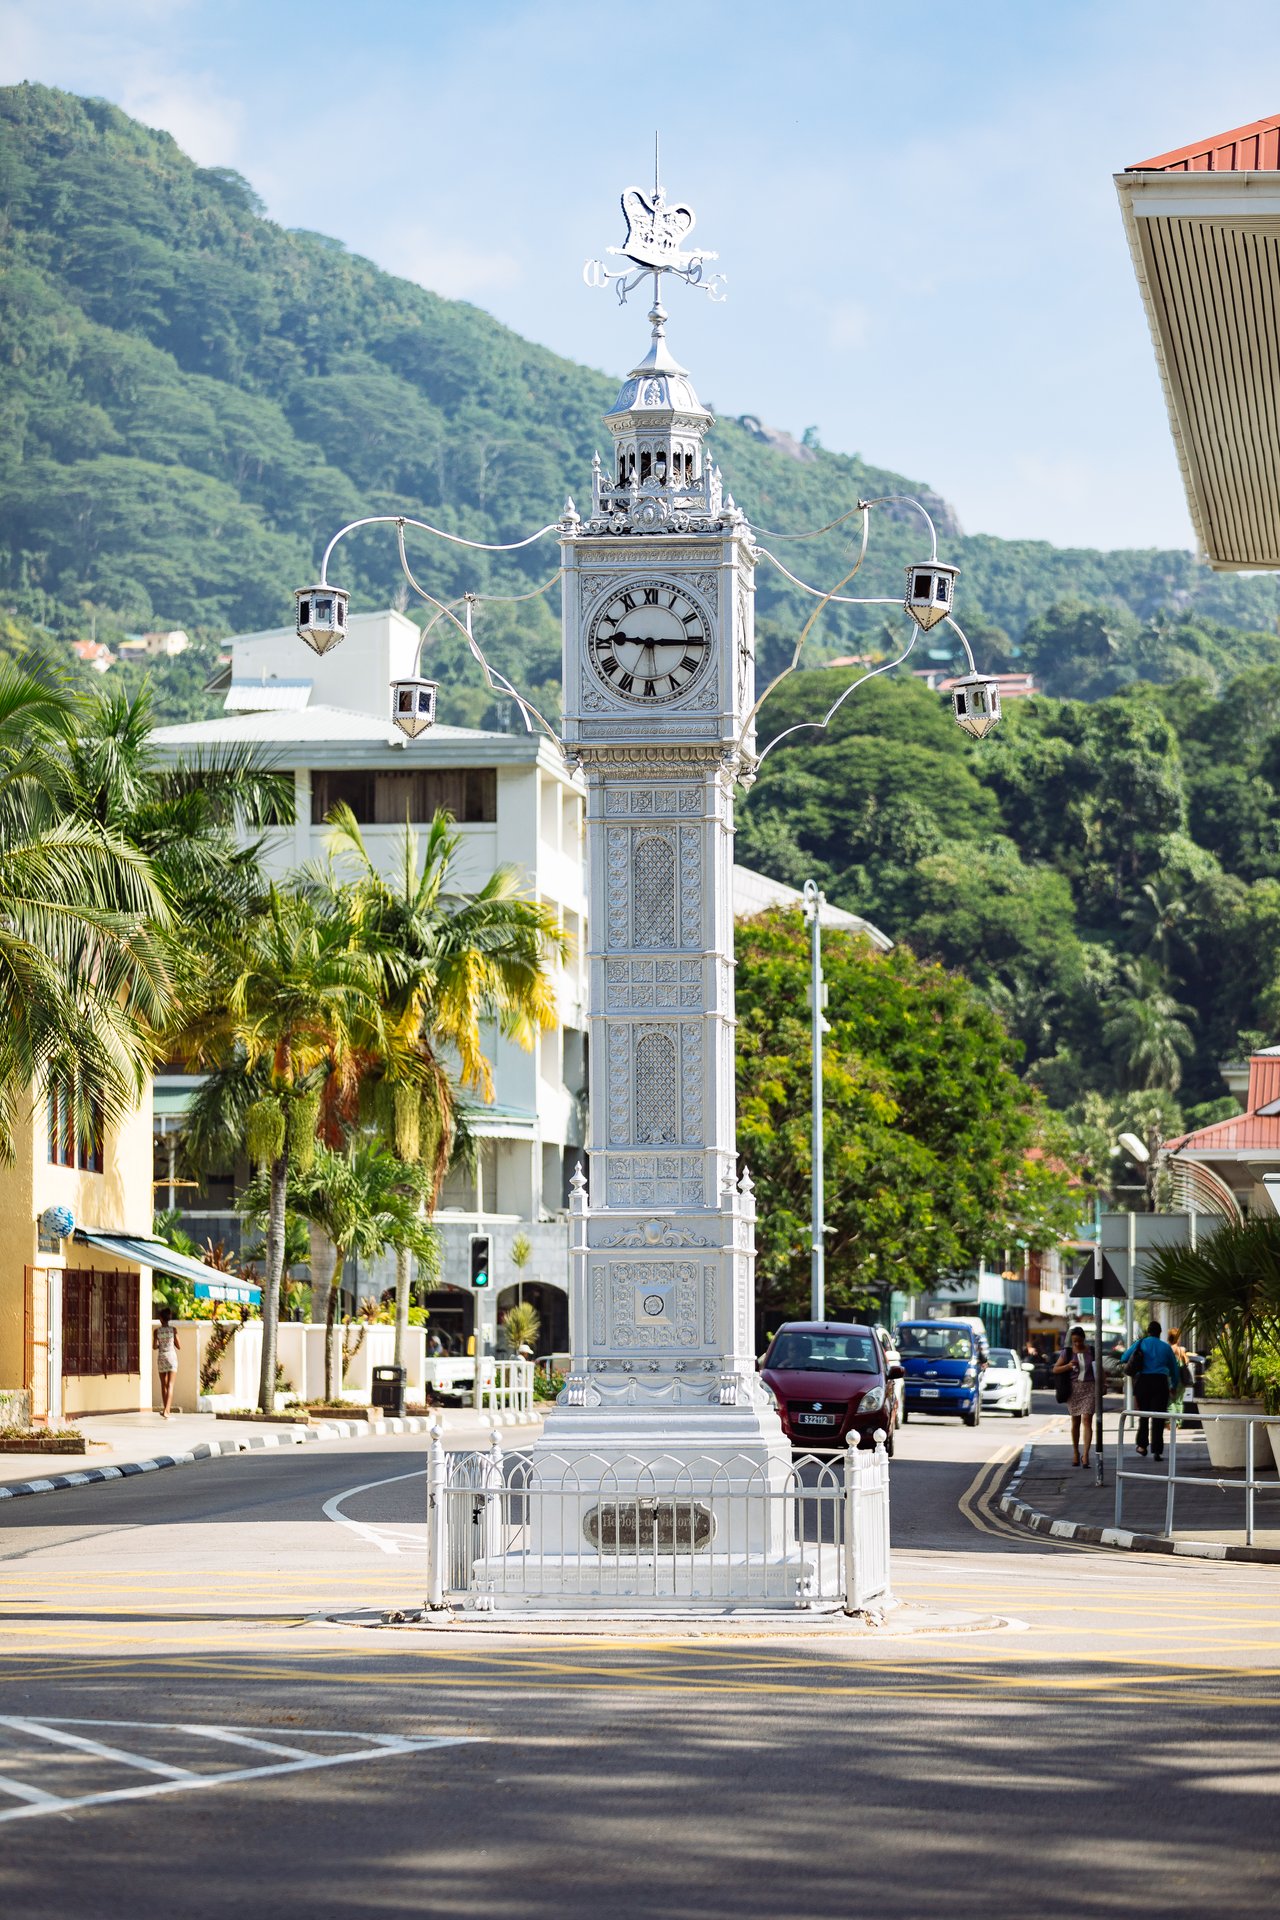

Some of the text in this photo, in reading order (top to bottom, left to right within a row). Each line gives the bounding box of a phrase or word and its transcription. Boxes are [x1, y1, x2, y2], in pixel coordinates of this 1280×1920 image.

[619, 594, 636, 612] XI
[644, 589, 658, 604] XII
[669, 596, 677, 609] I
[604, 615, 619, 627] X
[682, 613, 698, 624] II
[618, 673, 634, 692] VII
[644, 680, 657, 696] VI
[668, 674, 681, 690] V
[804, 1416, 827, 1424] S22112
